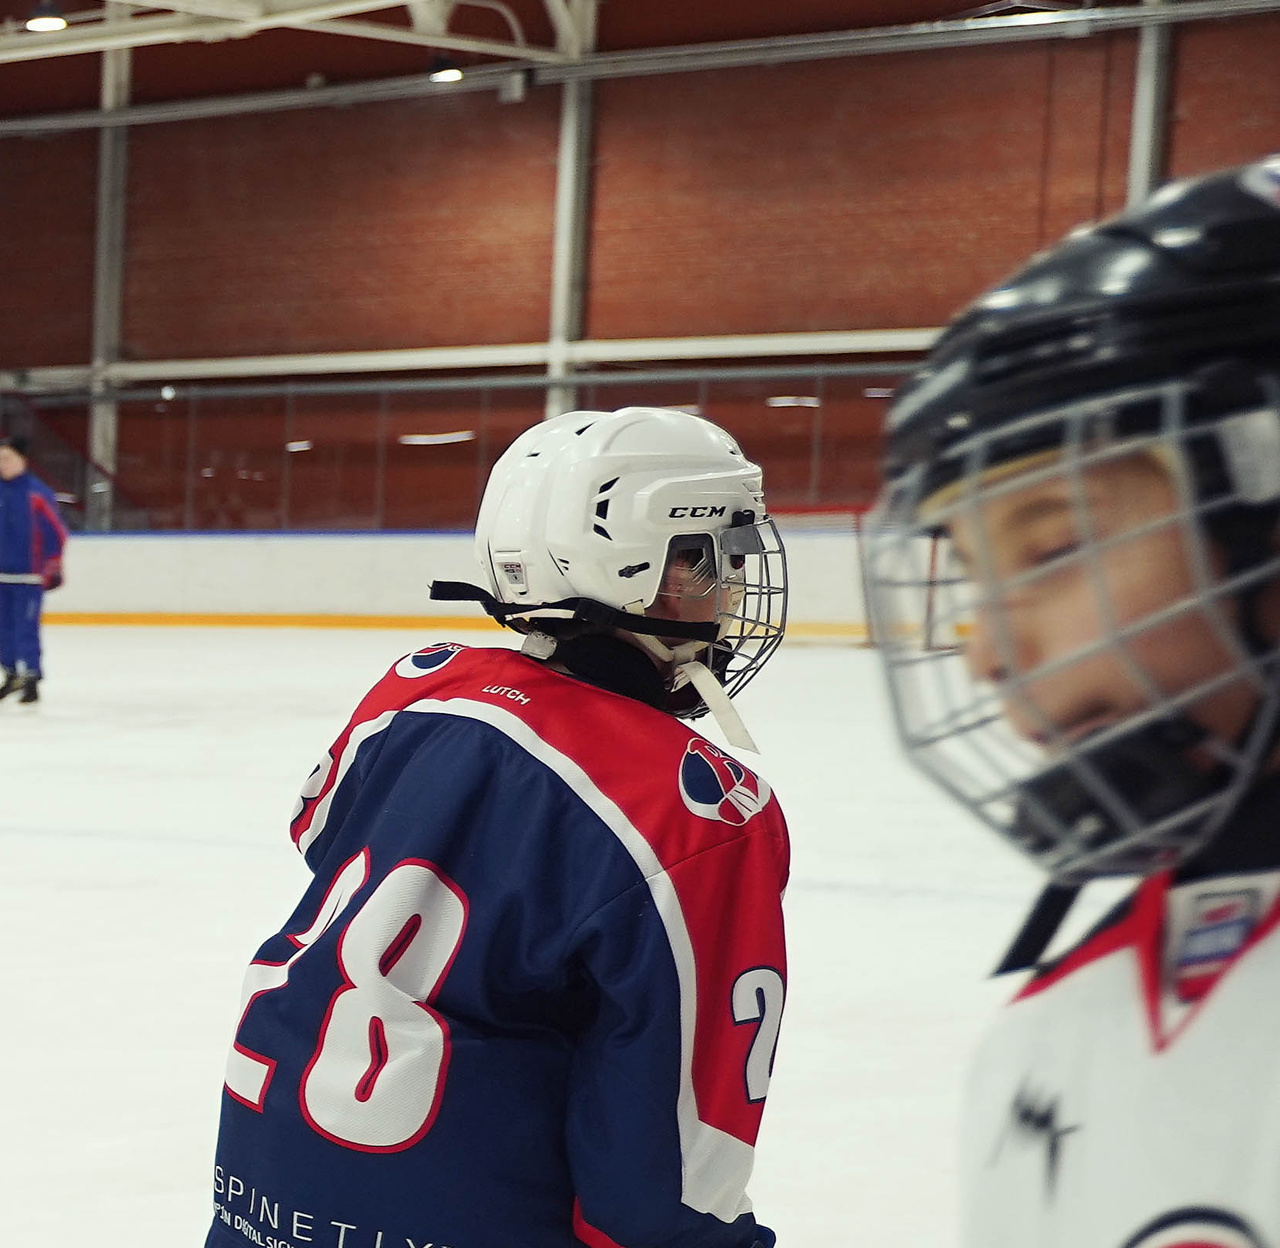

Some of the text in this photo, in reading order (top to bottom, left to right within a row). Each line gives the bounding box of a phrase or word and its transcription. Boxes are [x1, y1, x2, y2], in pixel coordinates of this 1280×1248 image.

[669, 506, 726, 519] CCM
[481, 684, 531, 706] LUTCH
[223, 847, 470, 1154] 28
[234, 1215, 266, 1247] DITAL
